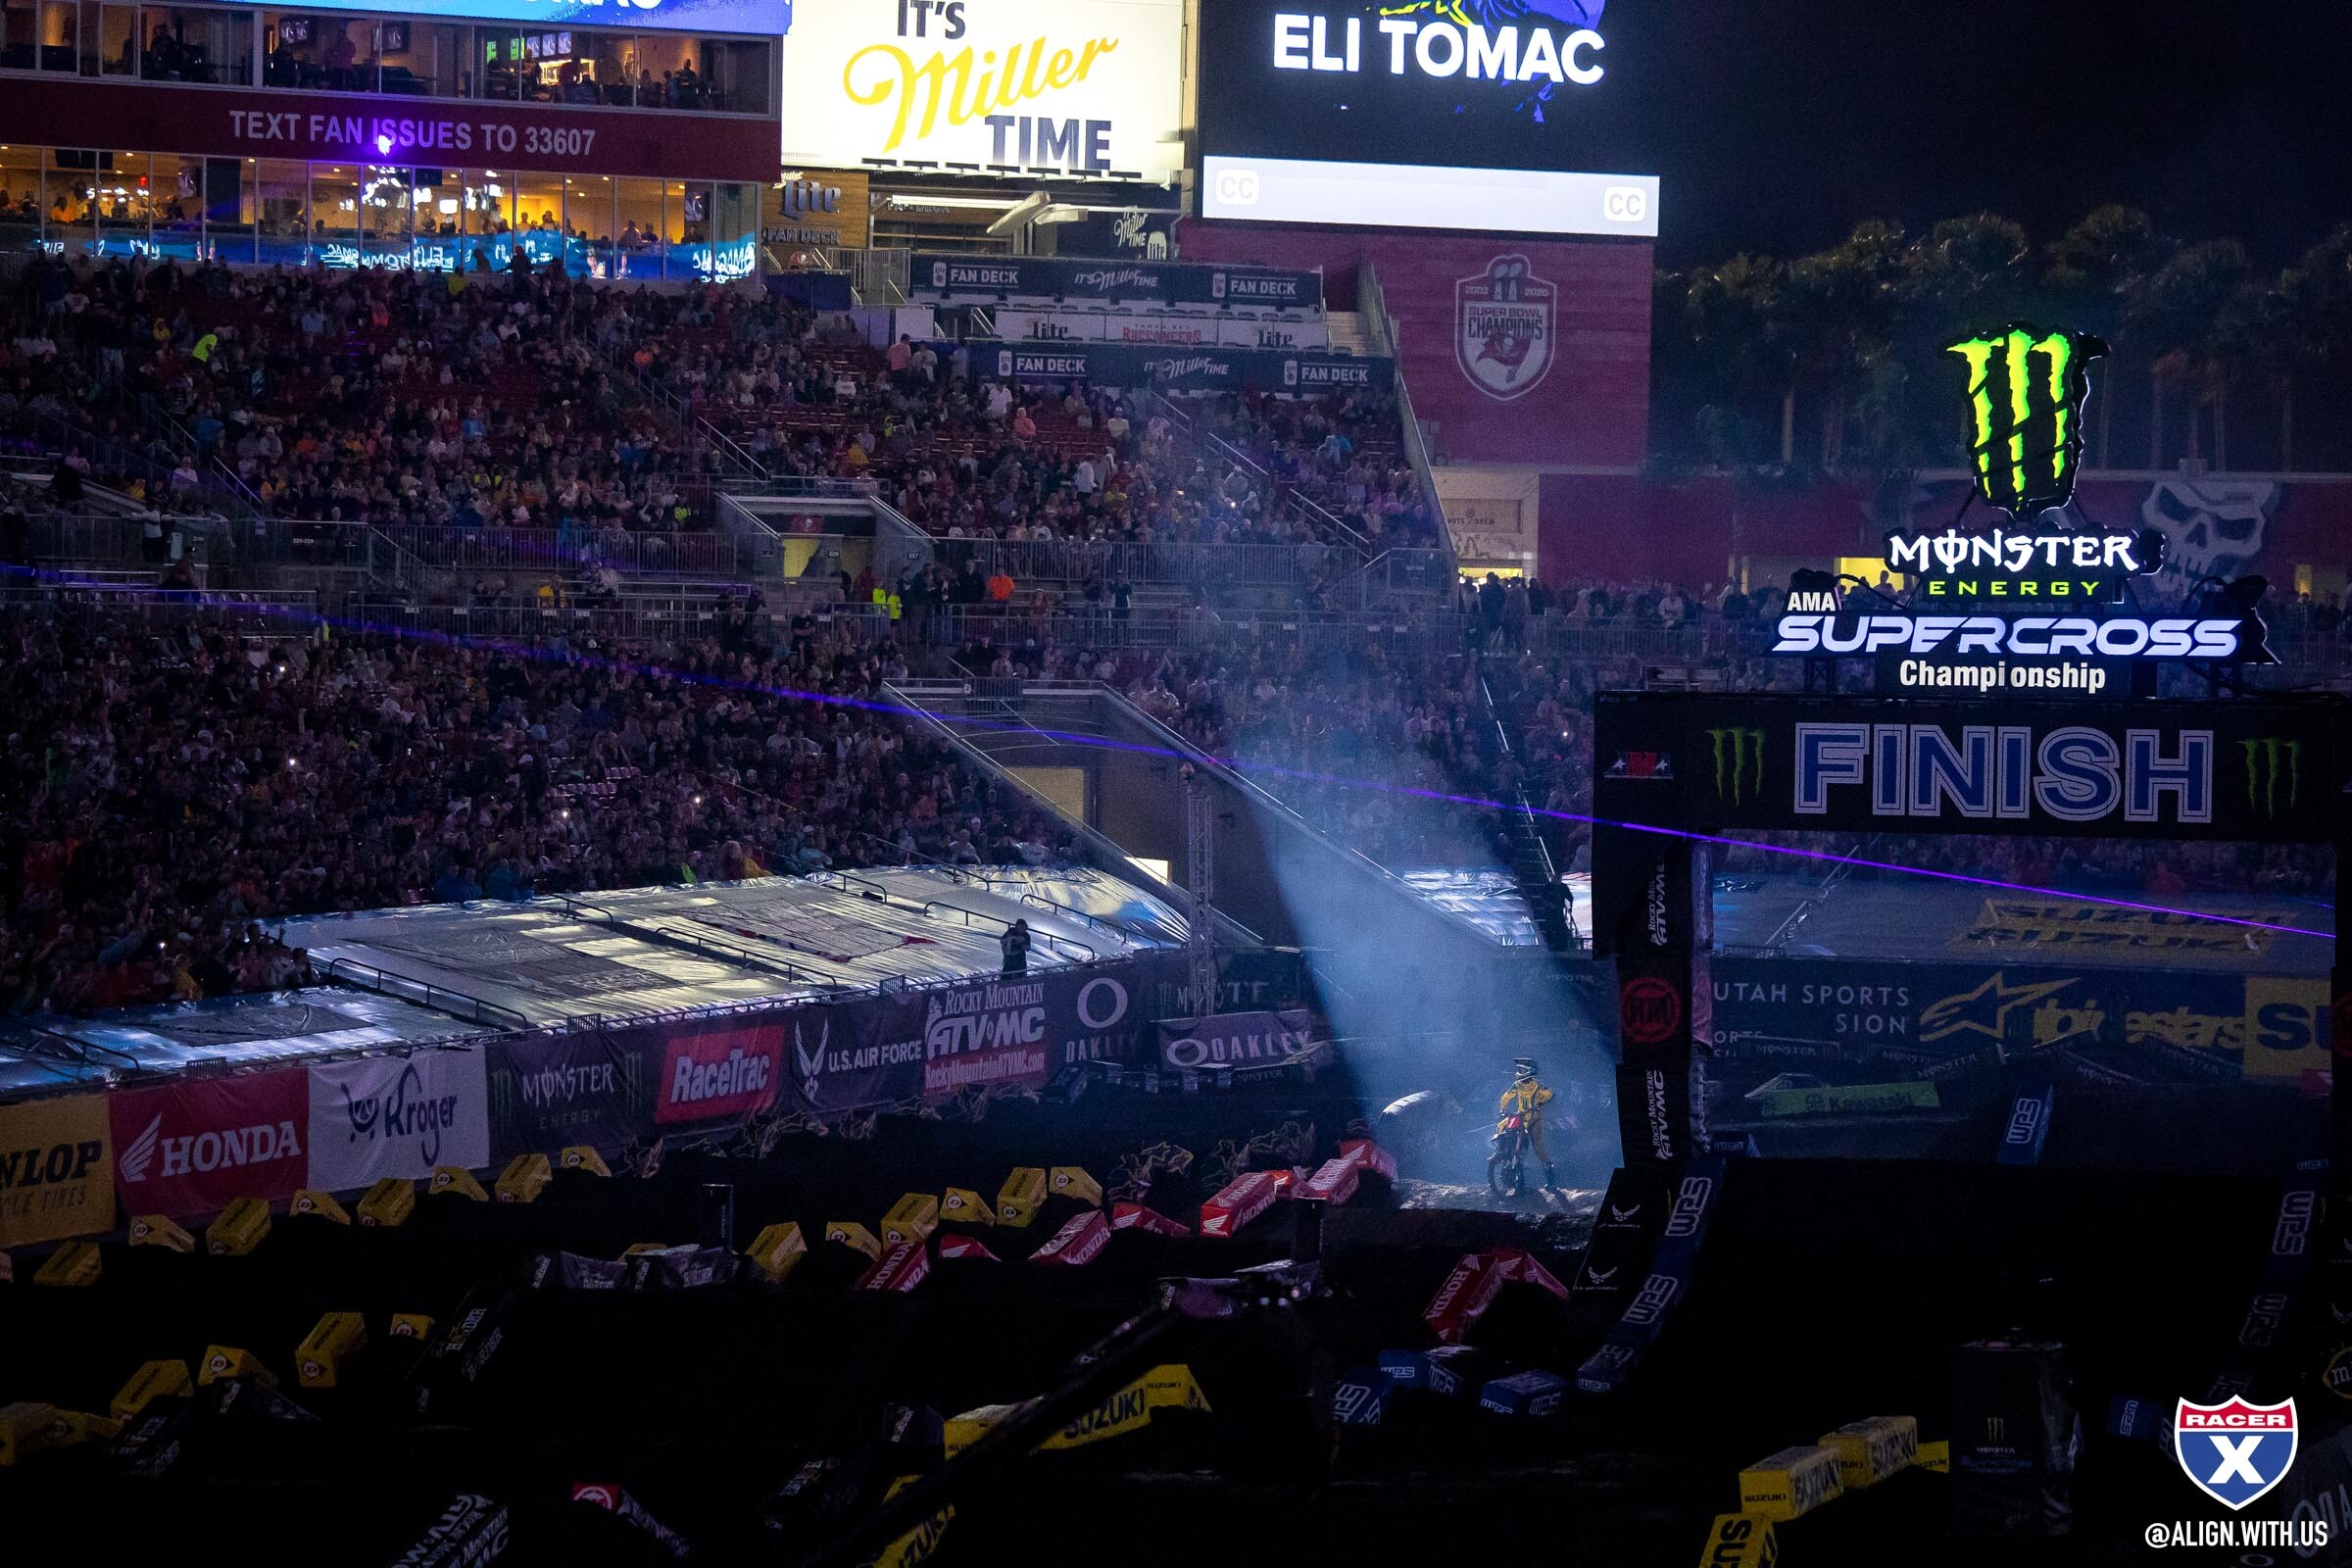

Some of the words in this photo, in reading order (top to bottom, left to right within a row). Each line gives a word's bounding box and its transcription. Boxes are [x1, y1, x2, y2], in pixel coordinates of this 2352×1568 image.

[898, 0, 966, 39] IT'S
[1274, 13, 1361, 72] ELI
[1379, 19, 1606, 84] TOMAC
[844, 36, 1118, 153] Miller
[229, 110, 302, 143] TEXT
[310, 114, 365, 146] FAN
[372, 117, 472, 150] ISSUES
[480, 124, 516, 153] TO
[524, 124, 596, 155] 33607
[985, 115, 1111, 169] TIME
[1608, 193, 1642, 217] CC
[767, 226, 799, 243] FAN
[802, 227, 841, 244] DECK
[950, 269, 978, 282] FAN
[981, 269, 1019, 284] DECK
[1133, 275, 1159, 287] TIME
[1231, 280, 1256, 293] FAN
[1259, 281, 1297, 295] DECK
[1469, 307, 1506, 317] SUPER
[1509, 308, 1543, 318] BOWL
[1468, 317, 1543, 340] CHAMPIONS
[1016, 358, 1044, 371] FAN
[1048, 359, 1086, 372] DECK
[1204, 364, 1229, 375] TIME
[1302, 368, 1327, 380] FAN
[1331, 368, 1368, 383] DECK
[1887, 527, 2141, 575] MONSTER
[1788, 592, 1836, 612] AMA
[1928, 580, 2100, 596] ENERGY
[1771, 615, 2244, 657] SUPERCROSS
[1899, 660, 2107, 693] Championship
[1793, 721, 2216, 823] FINISH
[946, 990, 981, 1014] ROCKY
[985, 983, 1045, 1009] MOUNTAIN
[1714, 983, 1788, 1003] UTAH
[1802, 985, 1909, 1006] SPORTS
[828, 1051, 853, 1072] U.S.
[855, 1047, 879, 1069] AIR
[881, 1041, 922, 1065] FORCE
[1211, 1031, 1311, 1061] OAKLEY
[670, 1049, 769, 1103] RaceTrac
[385, 1063, 458, 1166] Kroger
[161, 1120, 302, 1177] HONDA
[1063, 1389, 1146, 1440] SUZUKI
[1744, 1494, 1787, 1503] SUZUKI
